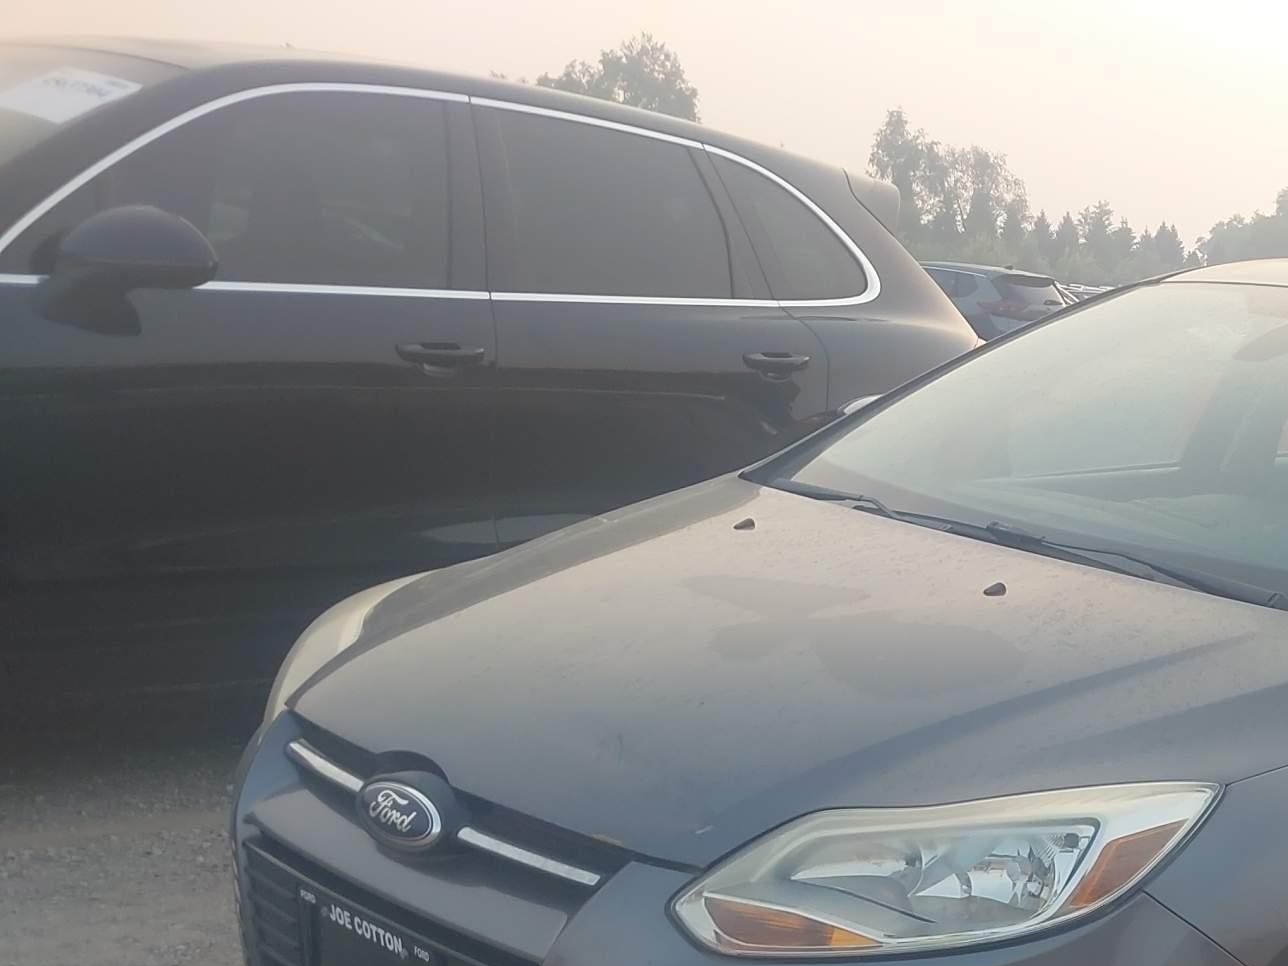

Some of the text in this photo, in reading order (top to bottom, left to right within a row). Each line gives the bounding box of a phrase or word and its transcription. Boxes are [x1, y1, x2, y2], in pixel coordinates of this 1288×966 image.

[369, 790, 417, 833] Ford
[329, 904, 352, 930] JOE
[354, 916, 402, 953] COTTON
[414, 945, 430, 962] FORD
